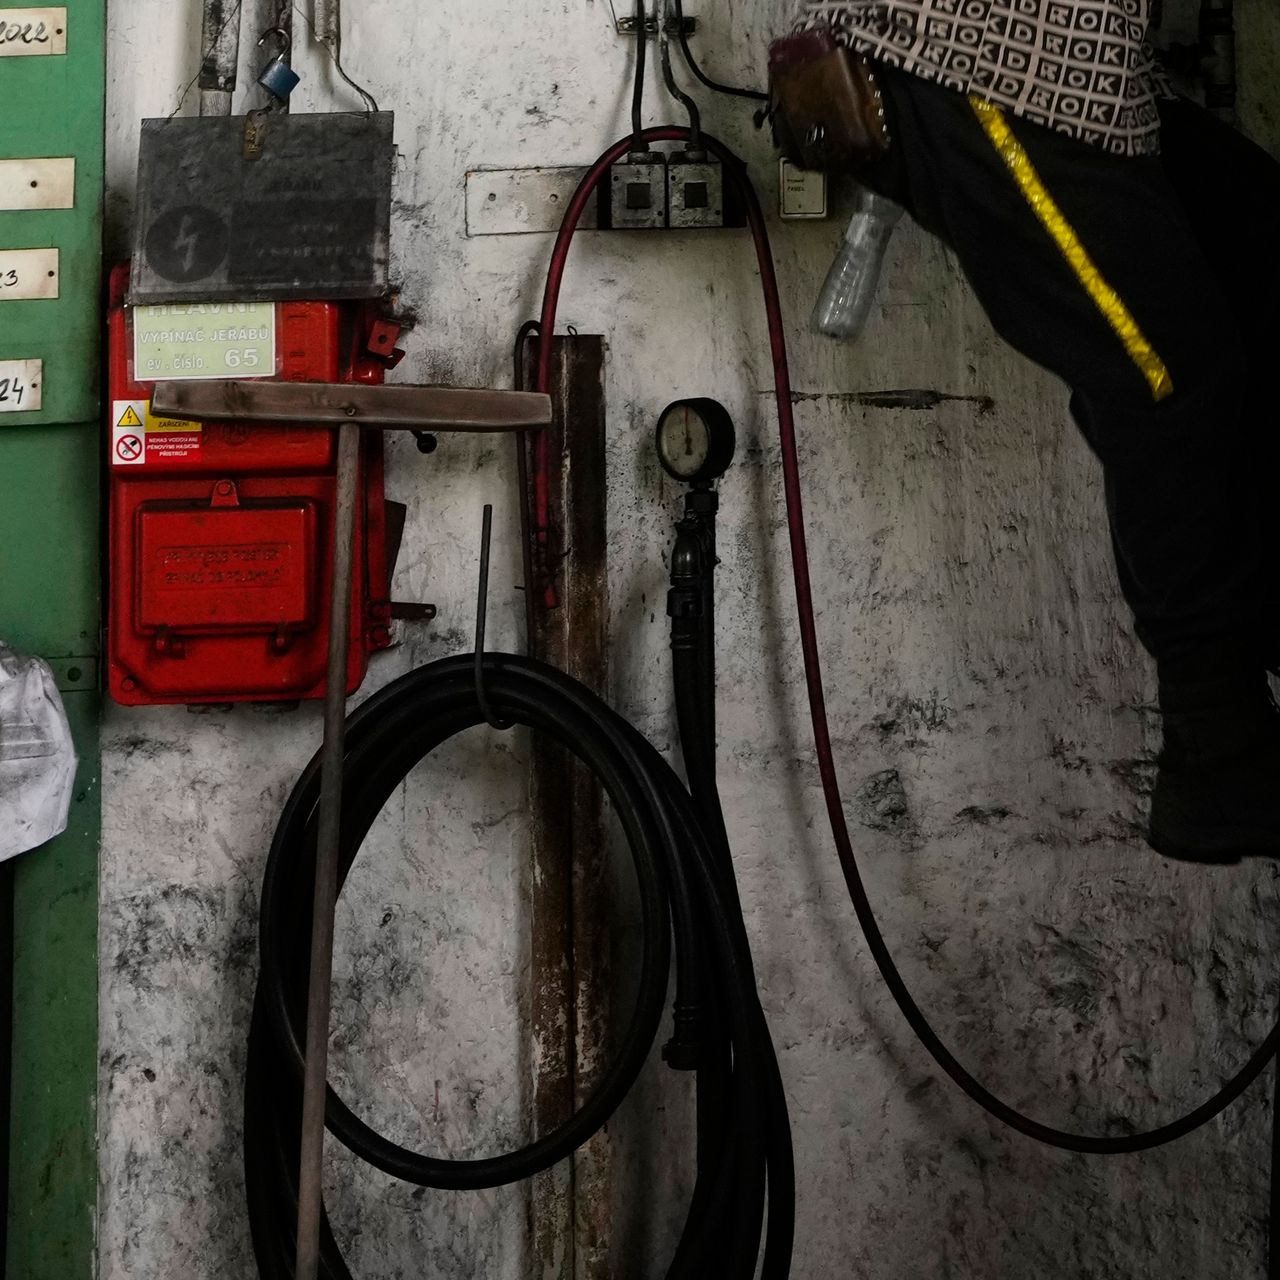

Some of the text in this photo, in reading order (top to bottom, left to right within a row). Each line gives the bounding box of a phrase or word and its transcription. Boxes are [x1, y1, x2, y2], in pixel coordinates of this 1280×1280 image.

[140, 324, 269, 344] VYPÍNAČ JEŘÁBŮ
[173, 353, 204, 369] číslo
[224, 347, 260, 368] 65
